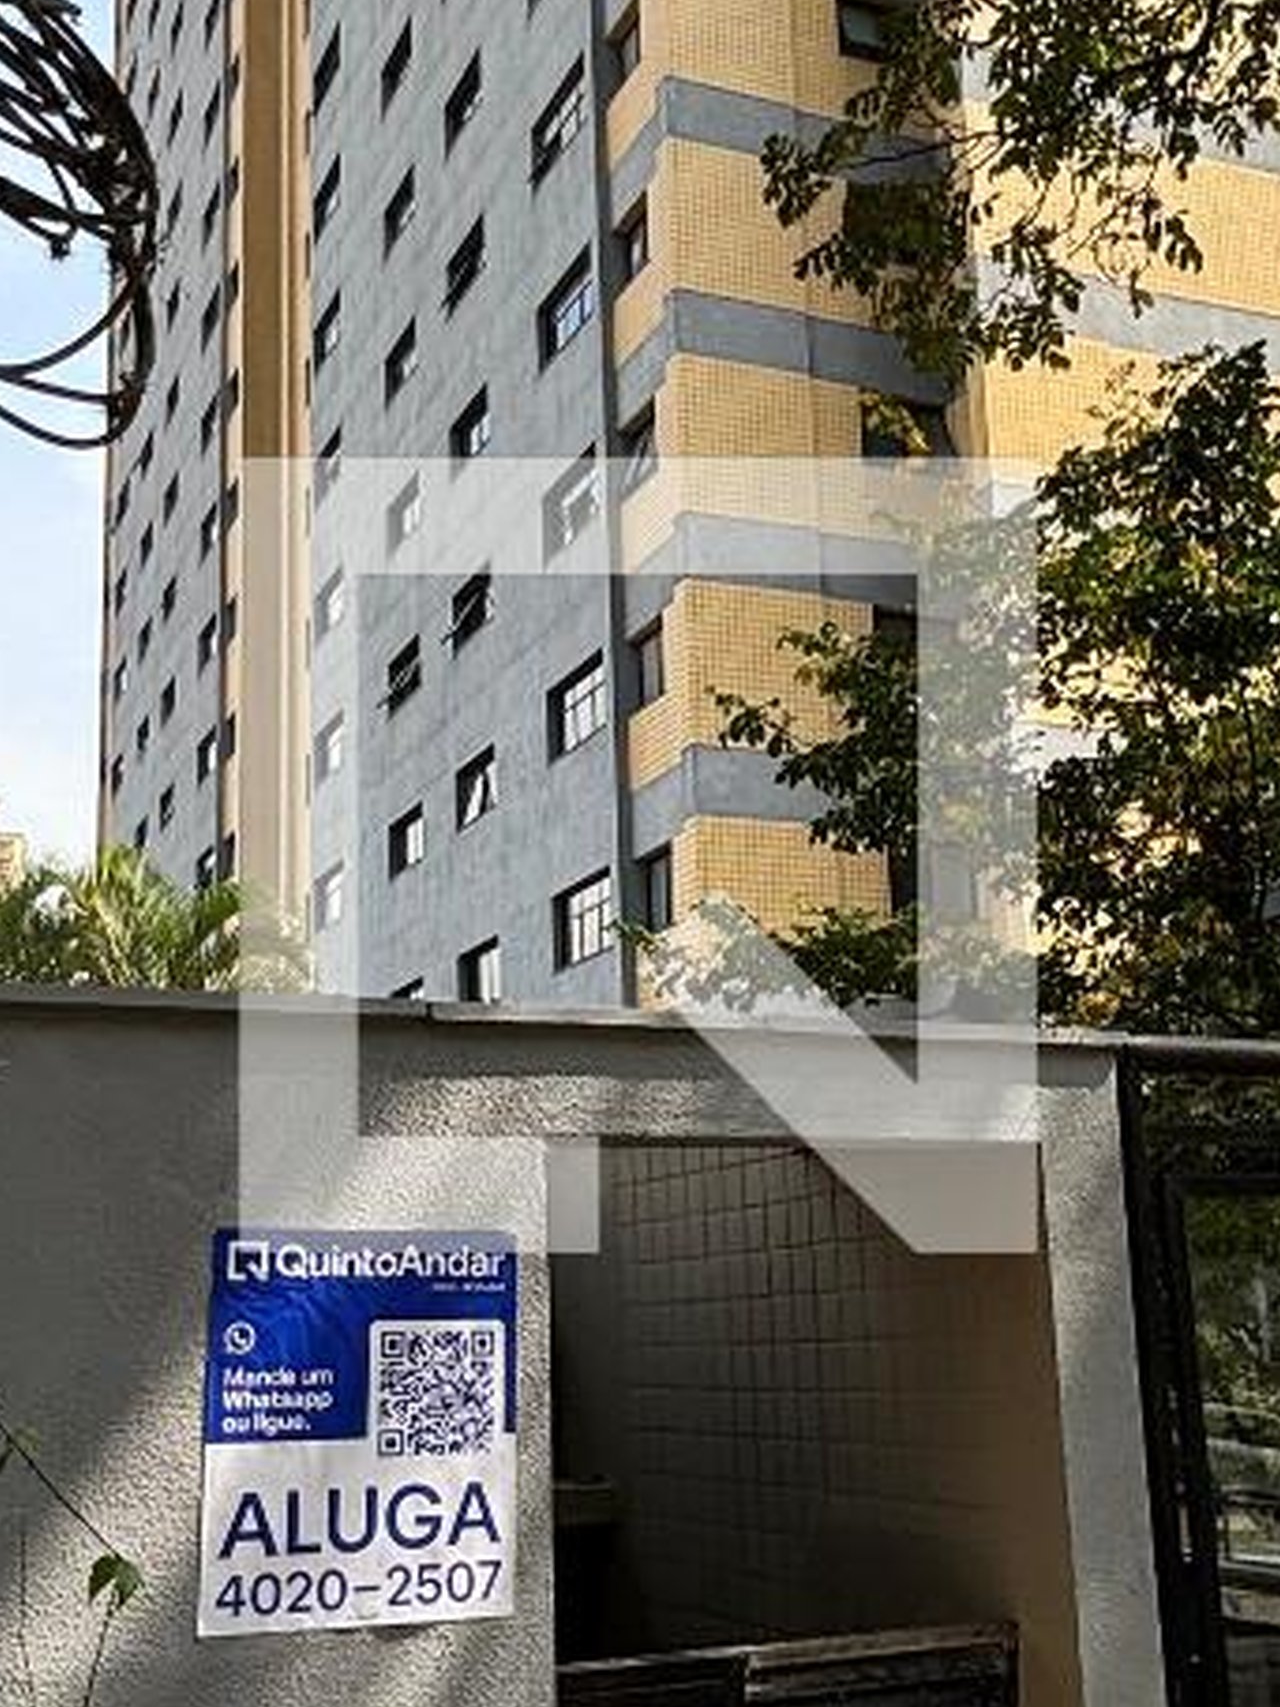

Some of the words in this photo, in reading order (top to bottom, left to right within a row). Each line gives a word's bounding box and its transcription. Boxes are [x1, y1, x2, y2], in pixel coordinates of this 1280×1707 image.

[274, 1244, 506, 1279] QuintoAndar
[301, 1368, 334, 1385] um
[218, 1481, 502, 1560] ALUGA
[215, 1559, 503, 1617] 4020-2507
